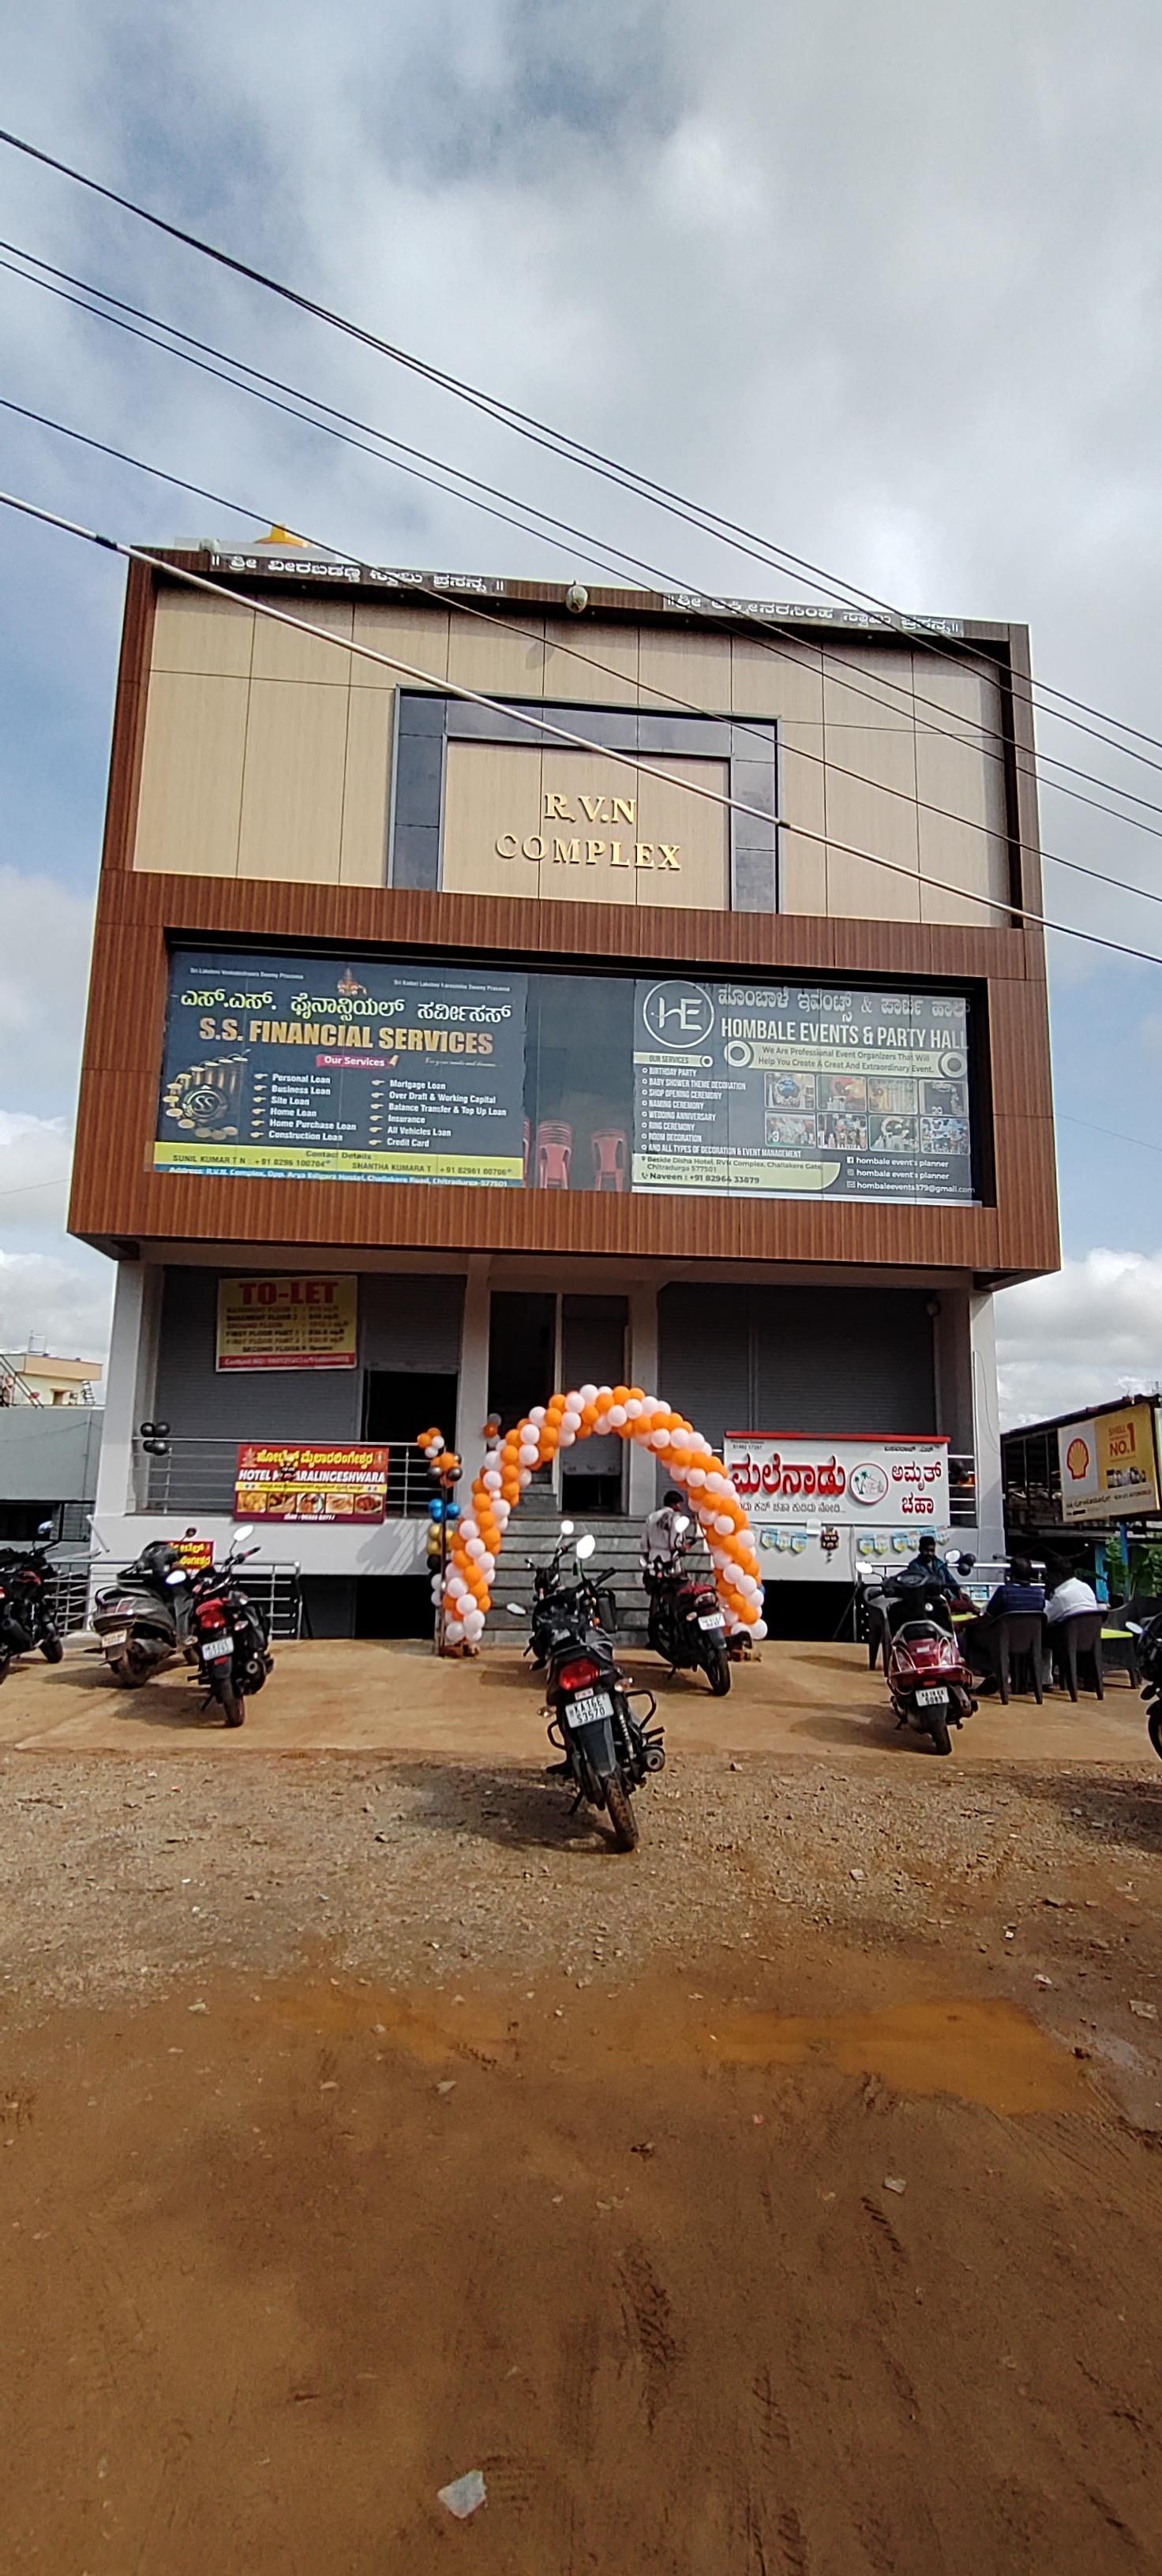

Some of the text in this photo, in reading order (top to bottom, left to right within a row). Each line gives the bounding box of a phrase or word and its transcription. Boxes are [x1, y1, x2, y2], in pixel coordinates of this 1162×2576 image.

[495, 833, 680, 870] COMPLEX
[861, 996, 872, 1013] &
[199, 1017, 493, 1054] S.S. FINANCIAL SERVICES
[722, 1017, 969, 1050] HOMBALE EVENTS & PARTY HALL
[762, 1046, 774, 1054] We
[790, 1048, 834, 1057] Professional
[857, 1052, 896, 1061] Organizers
[324, 1056, 385, 1066] Our Services
[662, 1055, 689, 1064] SERVICES
[759, 1058, 775, 1066] Help
[792, 1058, 816, 1067] Create
[862, 1063, 910, 1073] Extraordinary
[649, 1067, 677, 1076] BIRTHDAY
[272, 1073, 331, 1084] Personal Loan
[272, 1085, 309, 1094] Business
[390, 1080, 446, 1090] Mortgage Loan
[691, 1080, 710, 1089] THEME
[711, 1081, 746, 1090] DECORATION
[409, 1091, 427, 1100] Draft
[437, 1093, 468, 1103] Working
[470, 1095, 496, 1104] Capital
[691, 1091, 722, 1100] CEREMONY
[388, 1103, 418, 1112] Balance
[421, 1104, 452, 1113] Transfer
[462, 1106, 474, 1115] Top
[476, 1107, 487, 1117] Up
[488, 1107, 507, 1116] Loan
[649, 1100, 704, 1110] NAMING CEREMONY
[270, 1107, 294, 1116] Home
[649, 1111, 716, 1121] WEDDING ANNIVERSARY
[388, 1114, 425, 1124] Insurance
[296, 1120, 334, 1129] Purchase
[268, 1130, 343, 1141] Construction Loan
[399, 1127, 431, 1136] Vehicles
[411, 1139, 429, 1148] Card
[666, 1134, 703, 1143] DECORATION
[342, 1151, 372, 1160] Details
[673, 1145, 692, 1154] TYPES
[692, 1145, 700, 1154] OF
[701, 1146, 737, 1155] DECORATION
[742, 1148, 761, 1156] EVENT
[762, 1148, 801, 1158] MANAGEMENT
[733, 1160, 765, 1169] Complex,
[856, 1156, 890, 1165] hombale
[352, 1162, 388, 1170] SHANTHA
[647, 1163, 689, 1172] Chitradurga
[650, 1173, 683, 1181] Naveen
[857, 1169, 890, 1178] hombale
[920, 1172, 950, 1181] planner
[238, 1282, 338, 1305] TO-LET
[1126, 1421, 1136, 1452] 1
[238, 1470, 271, 1481] HOTEL
